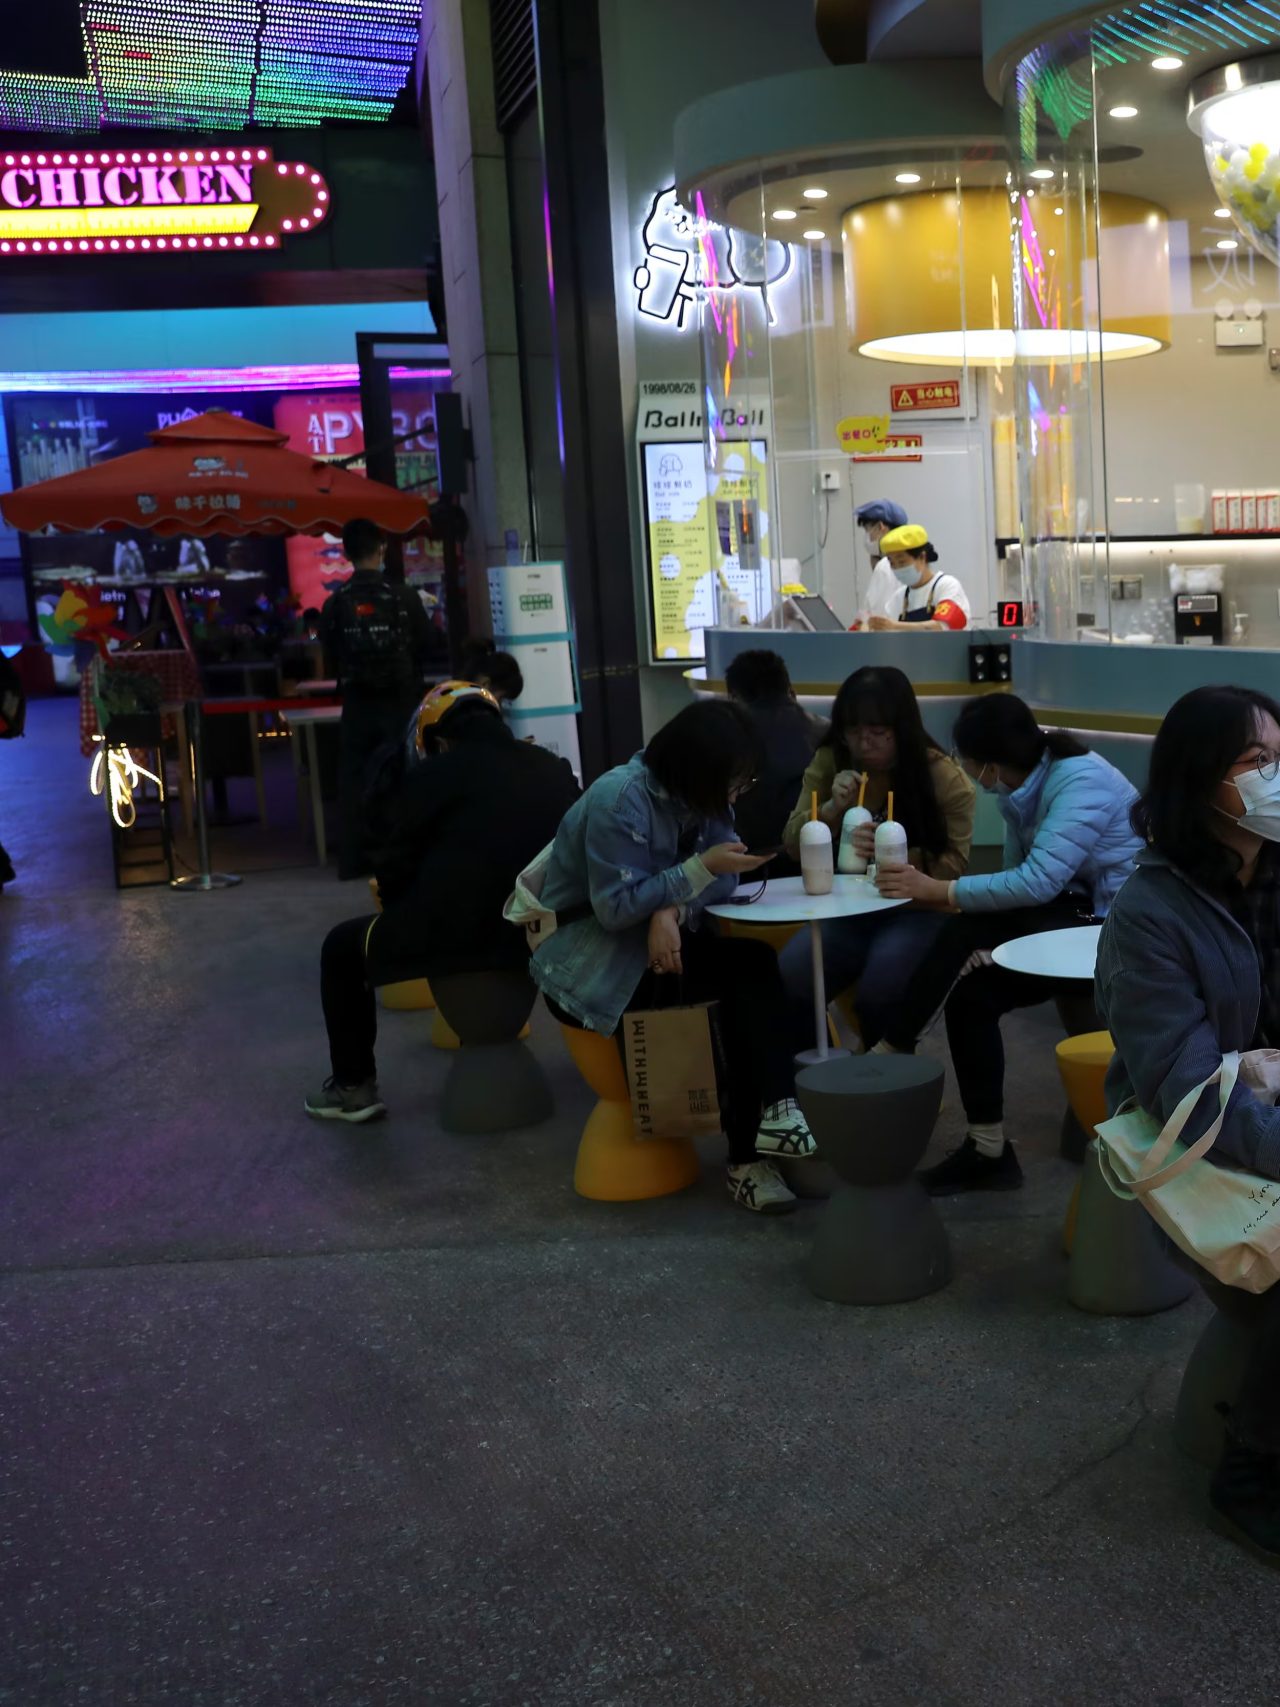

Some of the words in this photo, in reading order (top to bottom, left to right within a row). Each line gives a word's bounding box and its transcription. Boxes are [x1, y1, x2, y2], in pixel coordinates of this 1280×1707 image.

[1, 164, 253, 207] CHICKEN
[642, 382, 697, 395] 1998/08/26
[1003, 603, 1018, 626] 0
